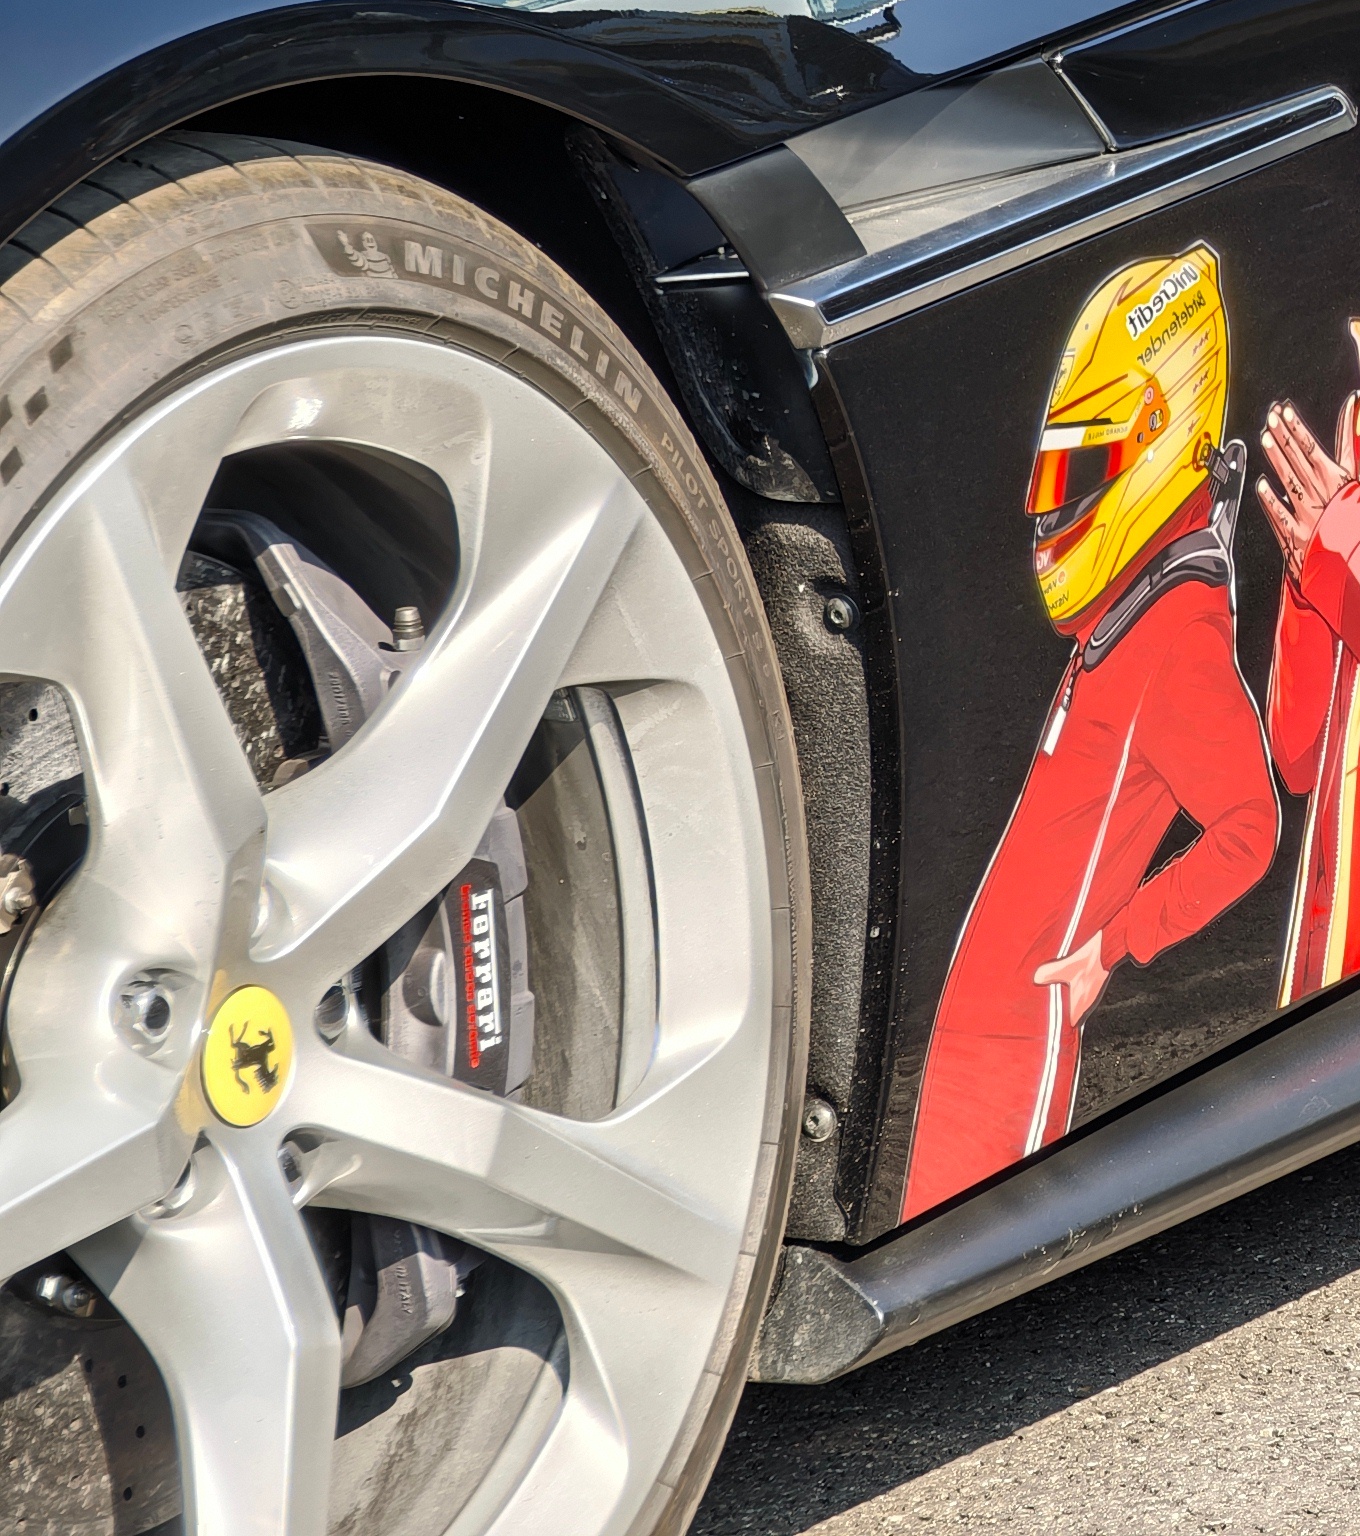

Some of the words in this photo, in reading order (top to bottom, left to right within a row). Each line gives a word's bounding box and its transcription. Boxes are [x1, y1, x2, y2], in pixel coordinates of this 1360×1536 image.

[404, 240, 642, 413] MICHELIN
[660, 431, 707, 510] PILOT
[708, 519, 754, 620] SPORT
[470, 888, 502, 1052] Ferrari
